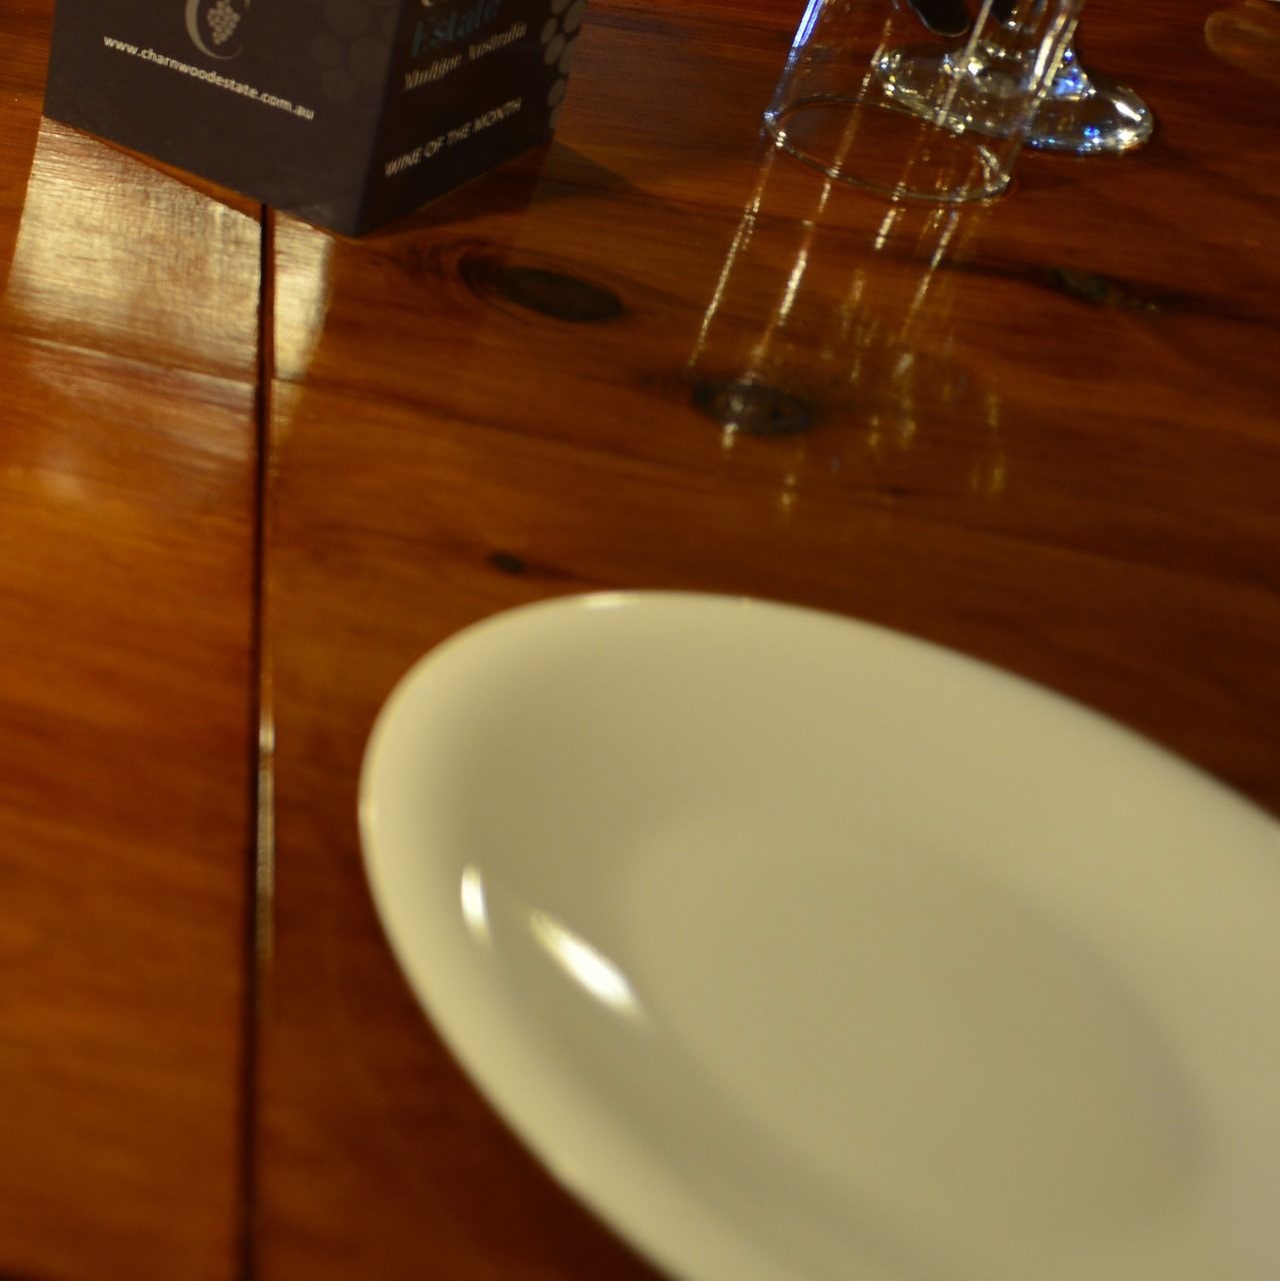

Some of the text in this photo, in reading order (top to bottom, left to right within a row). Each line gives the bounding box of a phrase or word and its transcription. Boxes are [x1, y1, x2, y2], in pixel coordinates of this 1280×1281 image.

[104, 36, 314, 120] www.charnwoodestate.com.au
[385, 97, 523, 178] WINE OF THE MONTH
